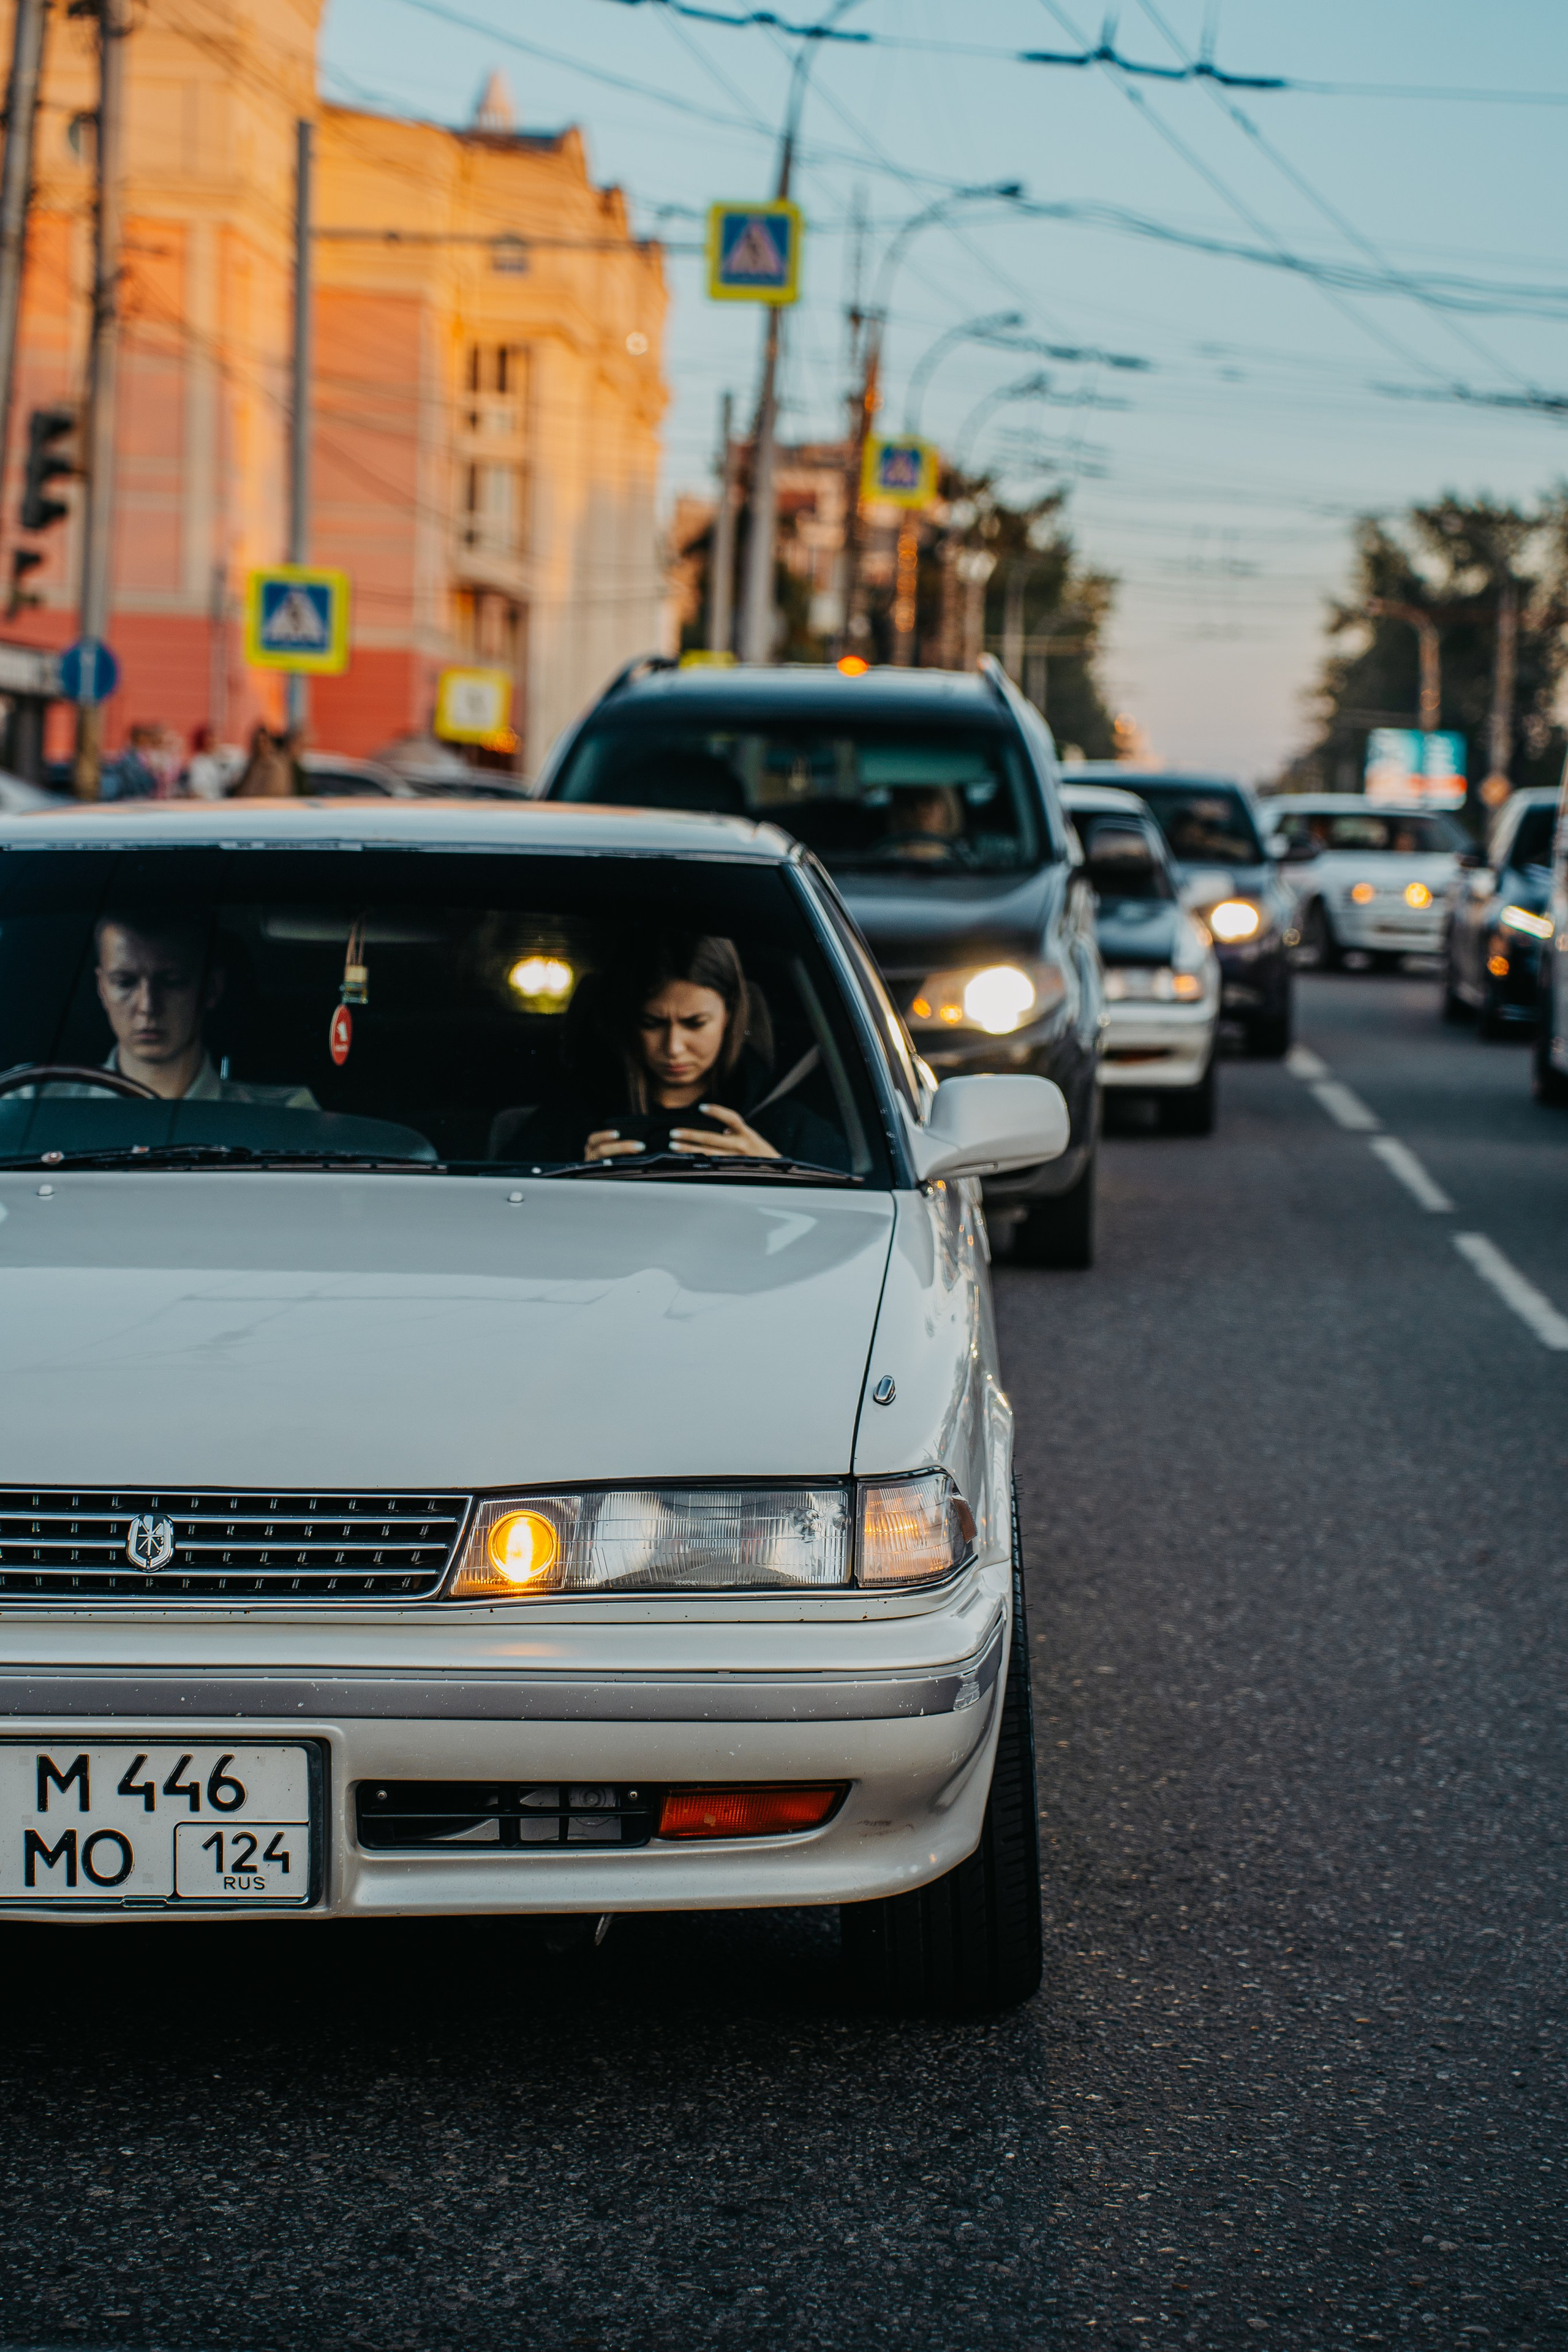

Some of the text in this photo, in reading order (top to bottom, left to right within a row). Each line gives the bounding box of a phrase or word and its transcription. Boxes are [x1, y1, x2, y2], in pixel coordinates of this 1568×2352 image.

[118, 1754, 246, 1812] 446
[202, 1831, 290, 1873] 124
[224, 1876, 266, 1890] RUS
